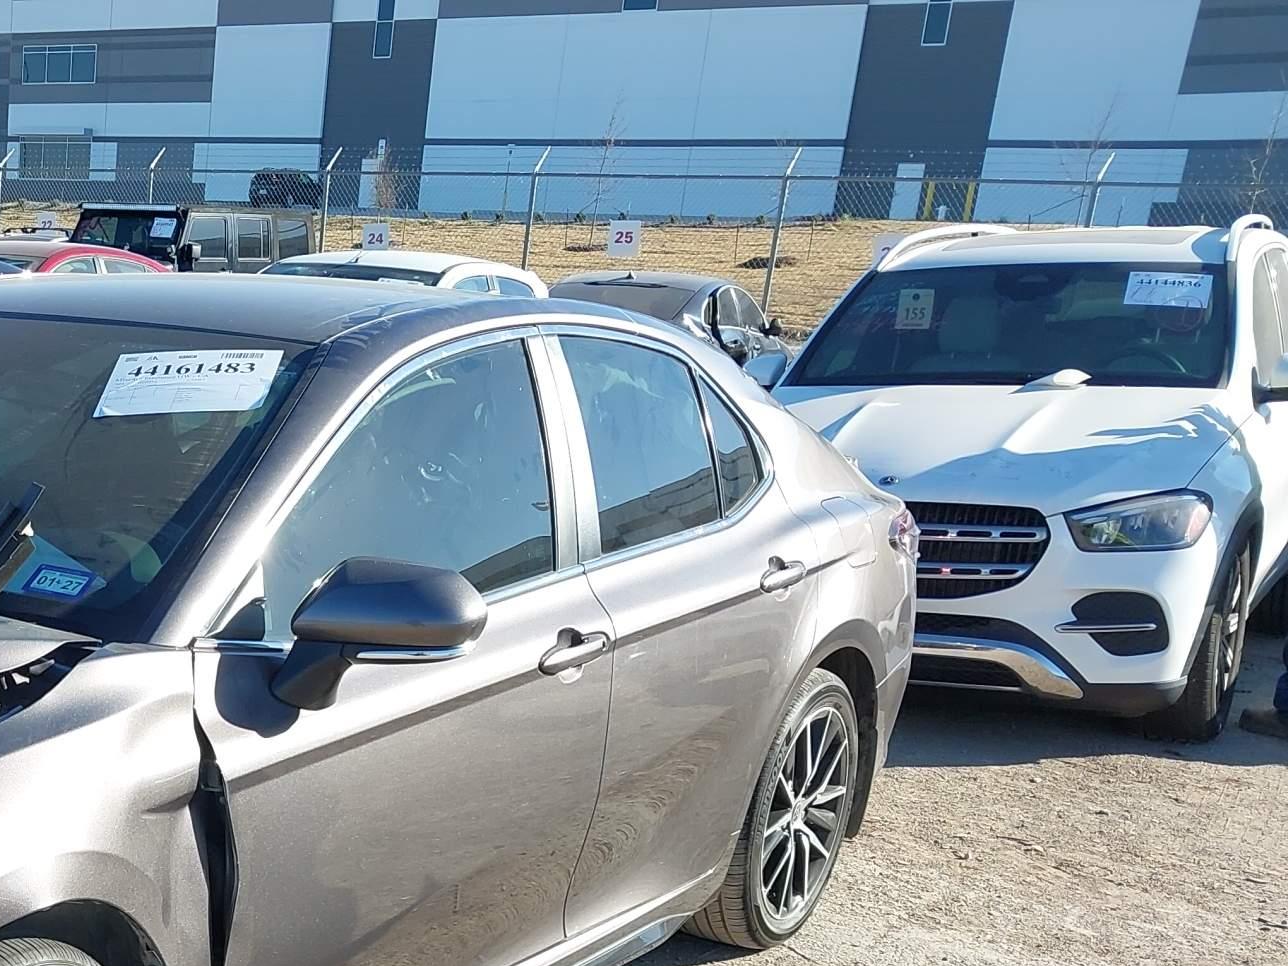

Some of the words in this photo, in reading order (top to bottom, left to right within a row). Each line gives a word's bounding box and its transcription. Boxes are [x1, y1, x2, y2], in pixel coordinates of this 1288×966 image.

[367, 233, 383, 245] 24
[614, 231, 633, 244] 25
[1136, 279, 1202, 288] 44144836
[905, 307, 927, 320] 155
[128, 362, 256, 377] 44161483
